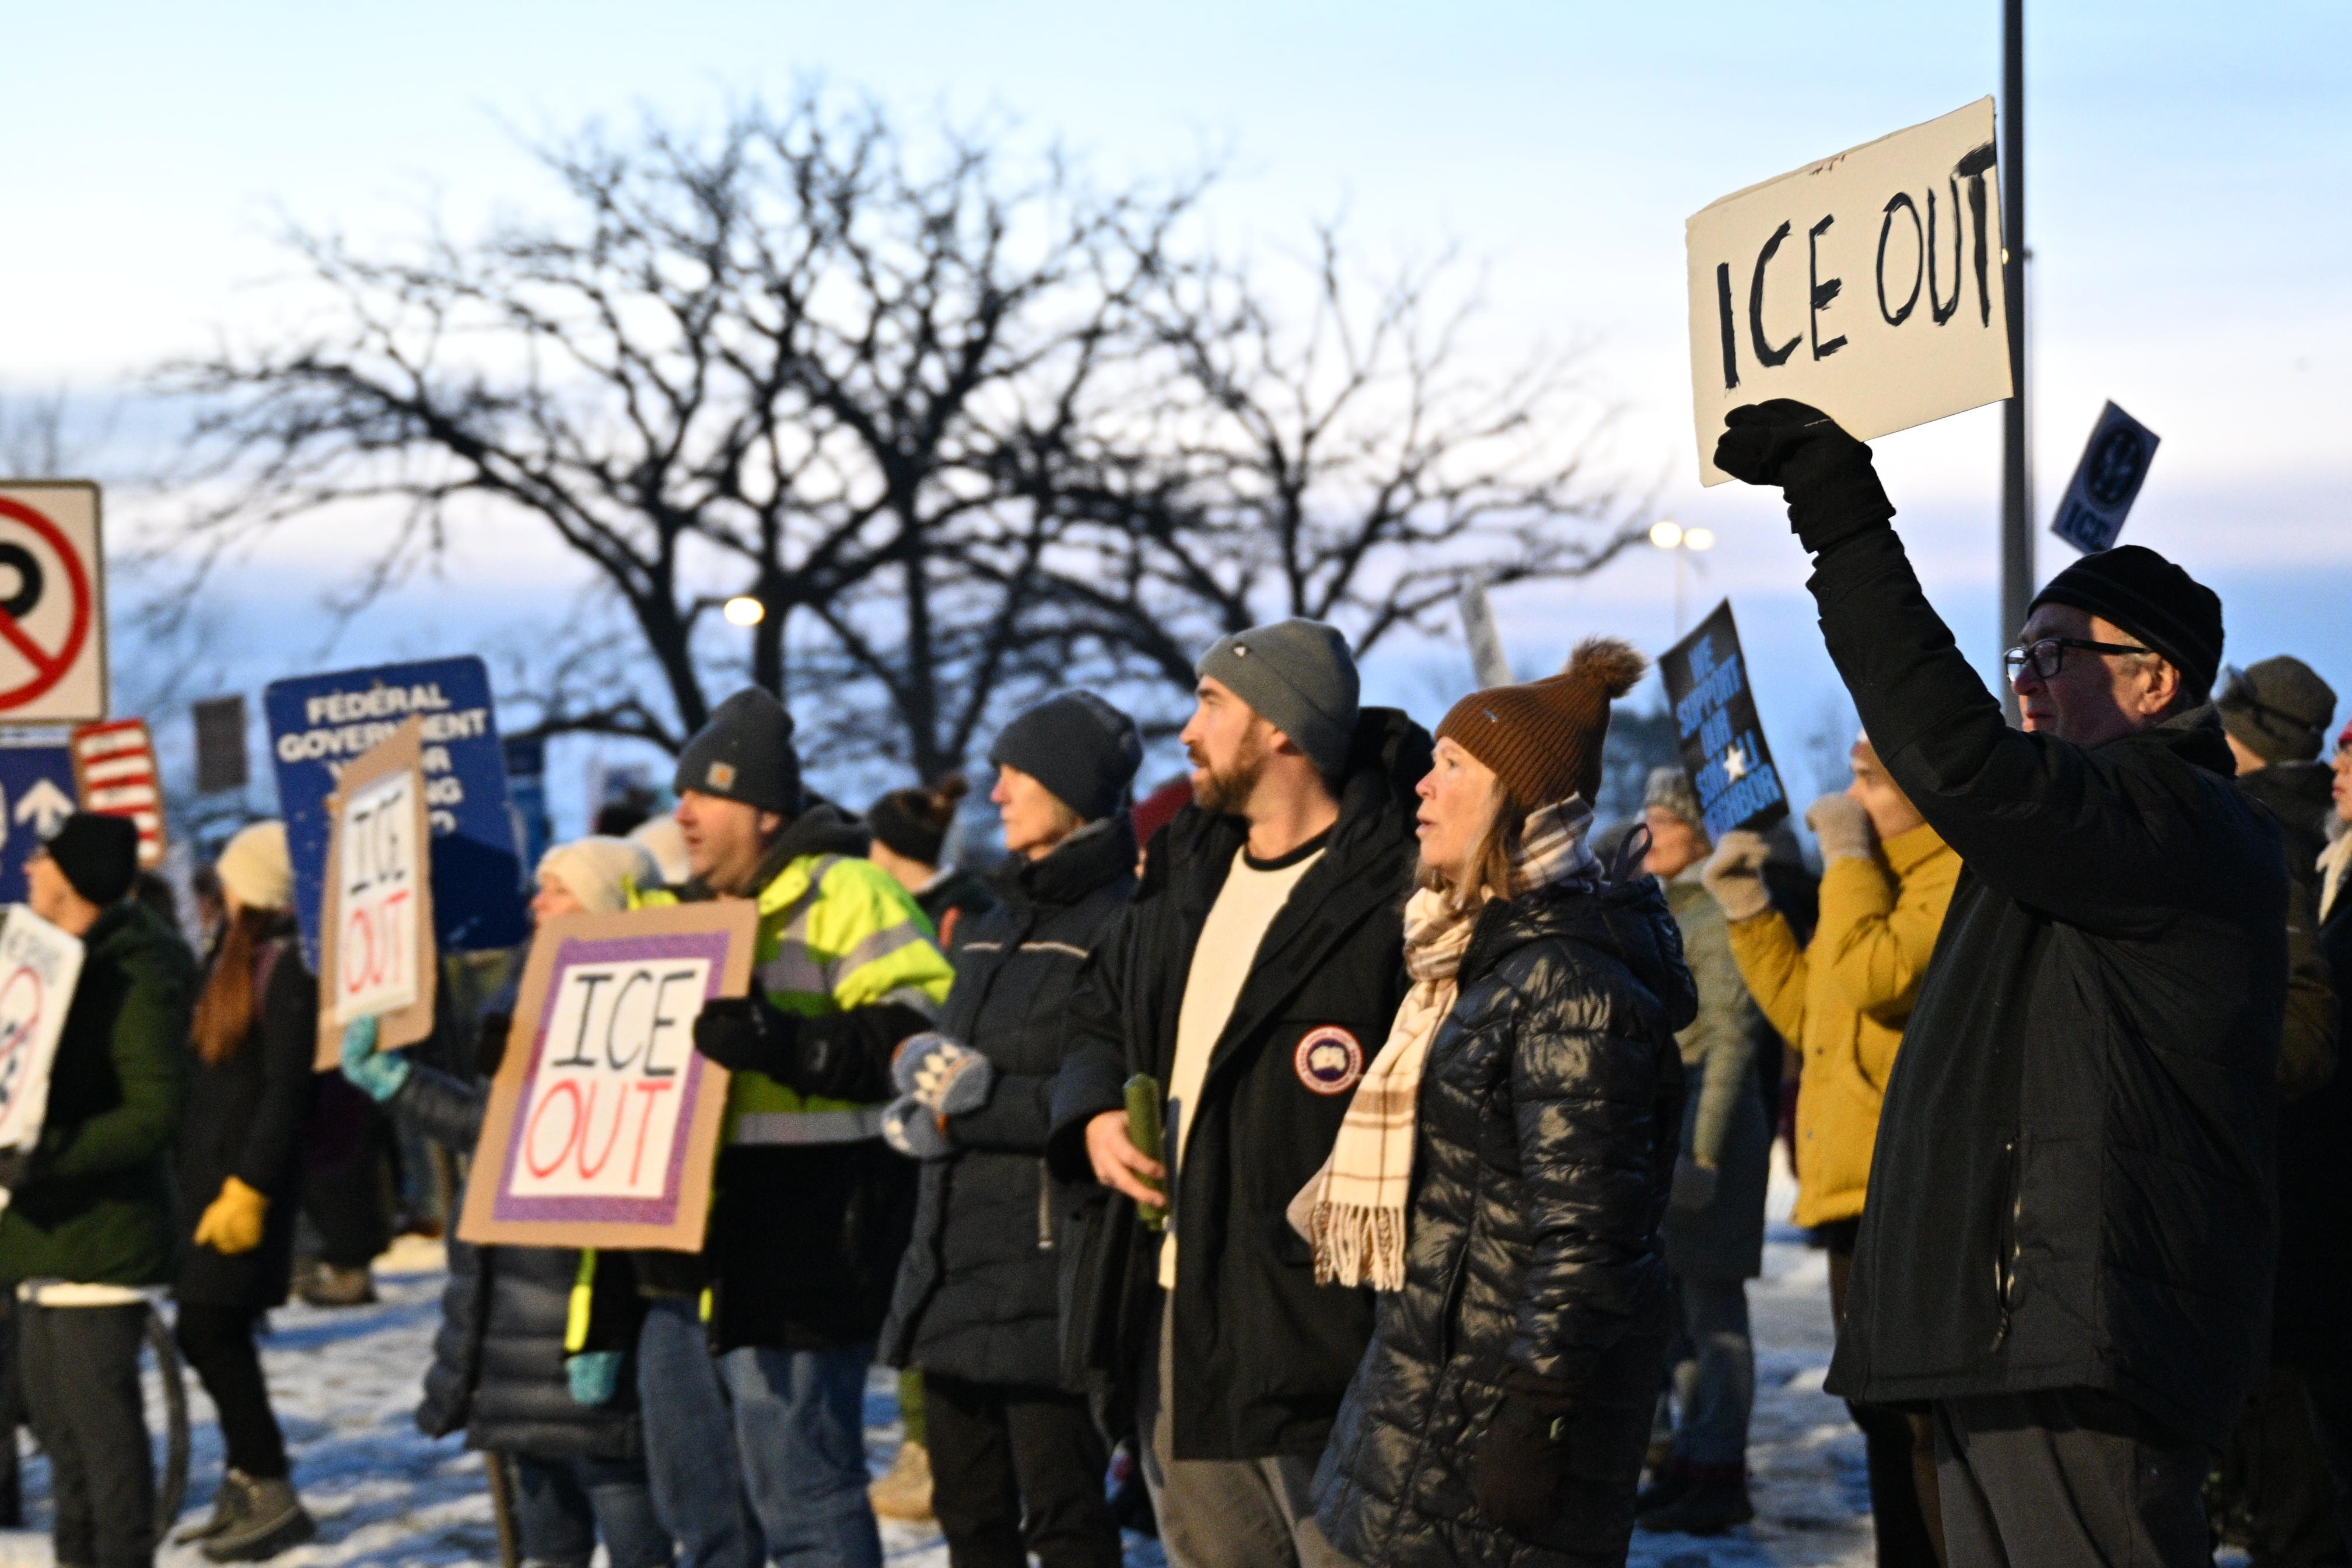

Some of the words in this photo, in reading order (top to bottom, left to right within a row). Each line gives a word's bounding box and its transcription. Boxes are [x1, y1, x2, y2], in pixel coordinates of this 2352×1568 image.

[1717, 214, 1848, 393] ICE
[1877, 141, 1997, 328] OUT
[277, 708, 488, 763] GOVERENT
[306, 683, 451, 725] FEDERAL
[346, 889, 411, 994] OUT
[551, 970, 696, 1077] ICE
[525, 1079, 674, 1188] OUT
